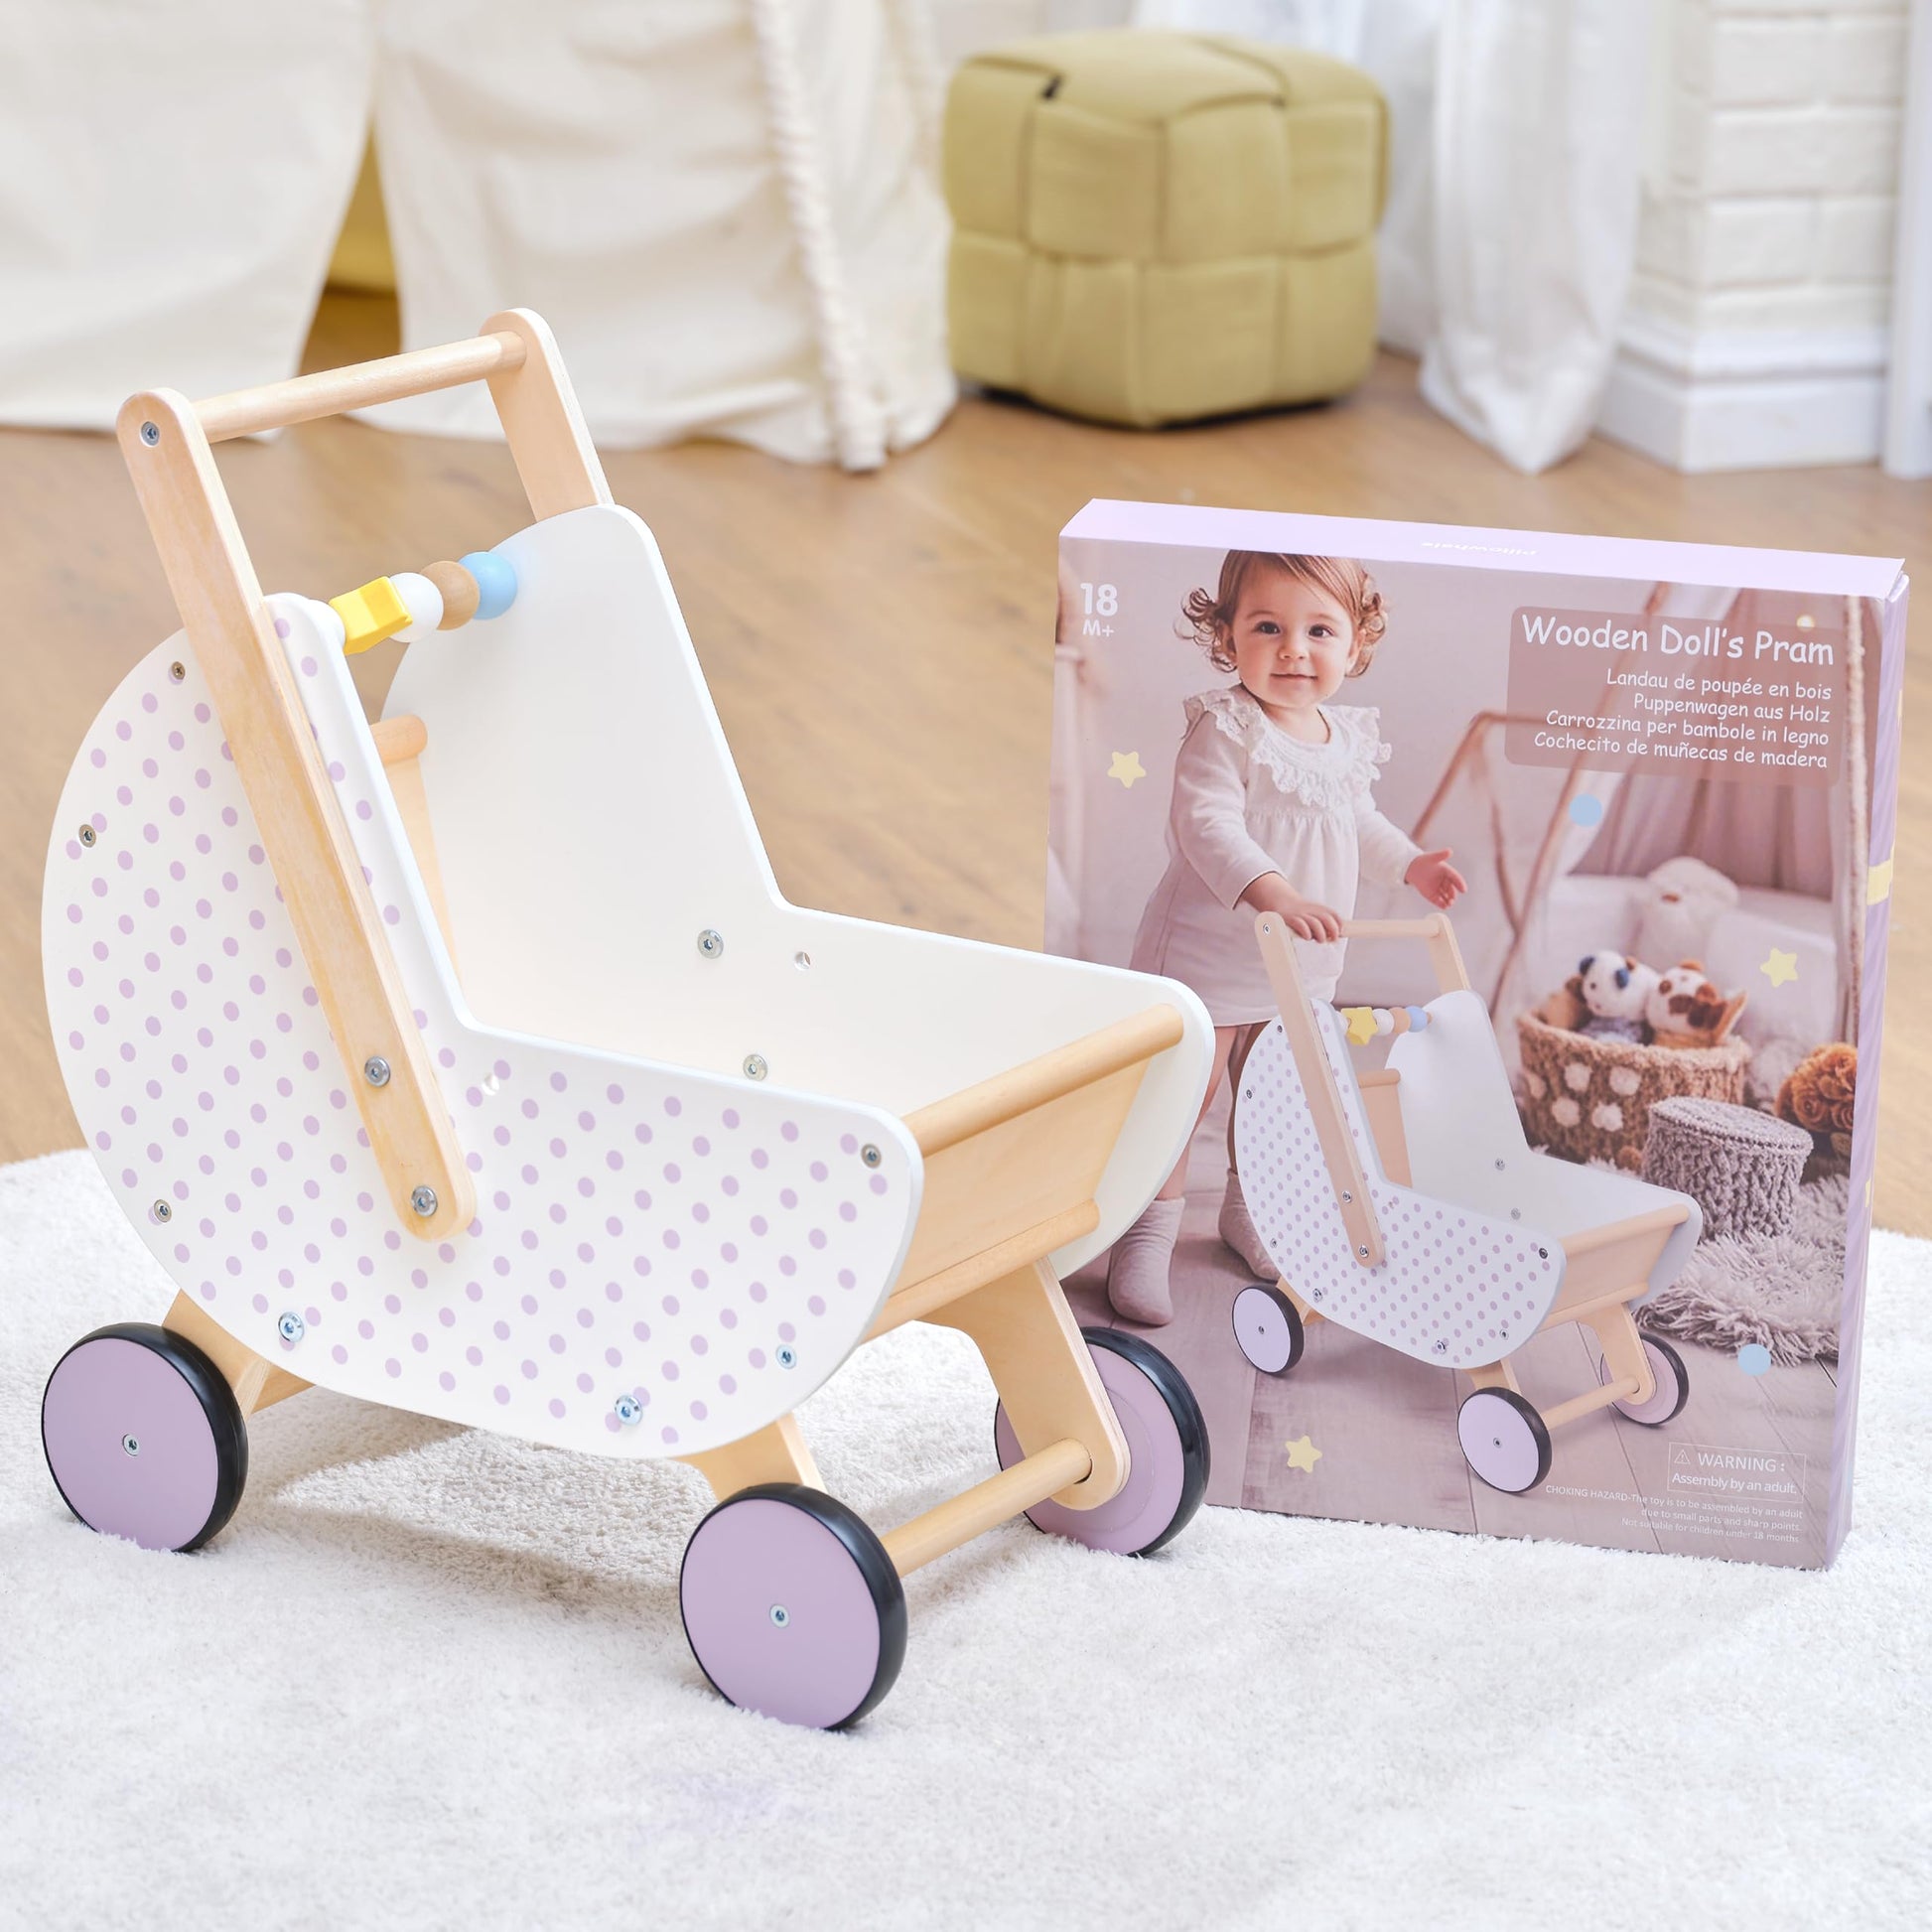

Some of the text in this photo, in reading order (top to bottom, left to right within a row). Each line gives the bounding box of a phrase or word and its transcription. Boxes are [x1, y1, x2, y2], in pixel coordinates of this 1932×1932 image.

[1080, 583, 1118, 617] 18
[1082, 619, 1115, 637] M+
[1521, 614, 1834, 665] Wooden Doll's Pram
[1606, 667, 1833, 700] Landau de poupée en bois
[1634, 692, 1831, 723] Puppenwagen aus Holz
[1546, 709, 1830, 749] Carrozzina per bambole in legno
[1534, 732, 1828, 768] Cochecito de muñecas de madera
[1672, 1472, 1797, 1495] Assembly by an adult.
[1545, 1484, 1588, 1497] CHOKING
[1650, 1496, 1665, 1507] toy
[1667, 1496, 1675, 1507] is
[1676, 1498, 1686, 1508] to
[1688, 1498, 1700, 1509] be
[1702, 1501, 1750, 1514] assembled
[1752, 1506, 1763, 1517] by
[1779, 1508, 1803, 1519] adult
[1621, 1517, 1637, 1527] Not
[1639, 1518, 1674, 1531] suitable
[1675, 1522, 1688, 1532] for
[1689, 1523, 1724, 1536] children
[1725, 1529, 1752, 1539] under
[1753, 1531, 1764, 1540] 18
[1641, 1508, 1659, 1518] due
[1661, 1510, 1671, 1519] to
[1673, 1512, 1697, 1522] small
[1699, 1514, 1722, 1525] parts
[1724, 1517, 1741, 1526] and
[1743, 1518, 1769, 1530] sharp
